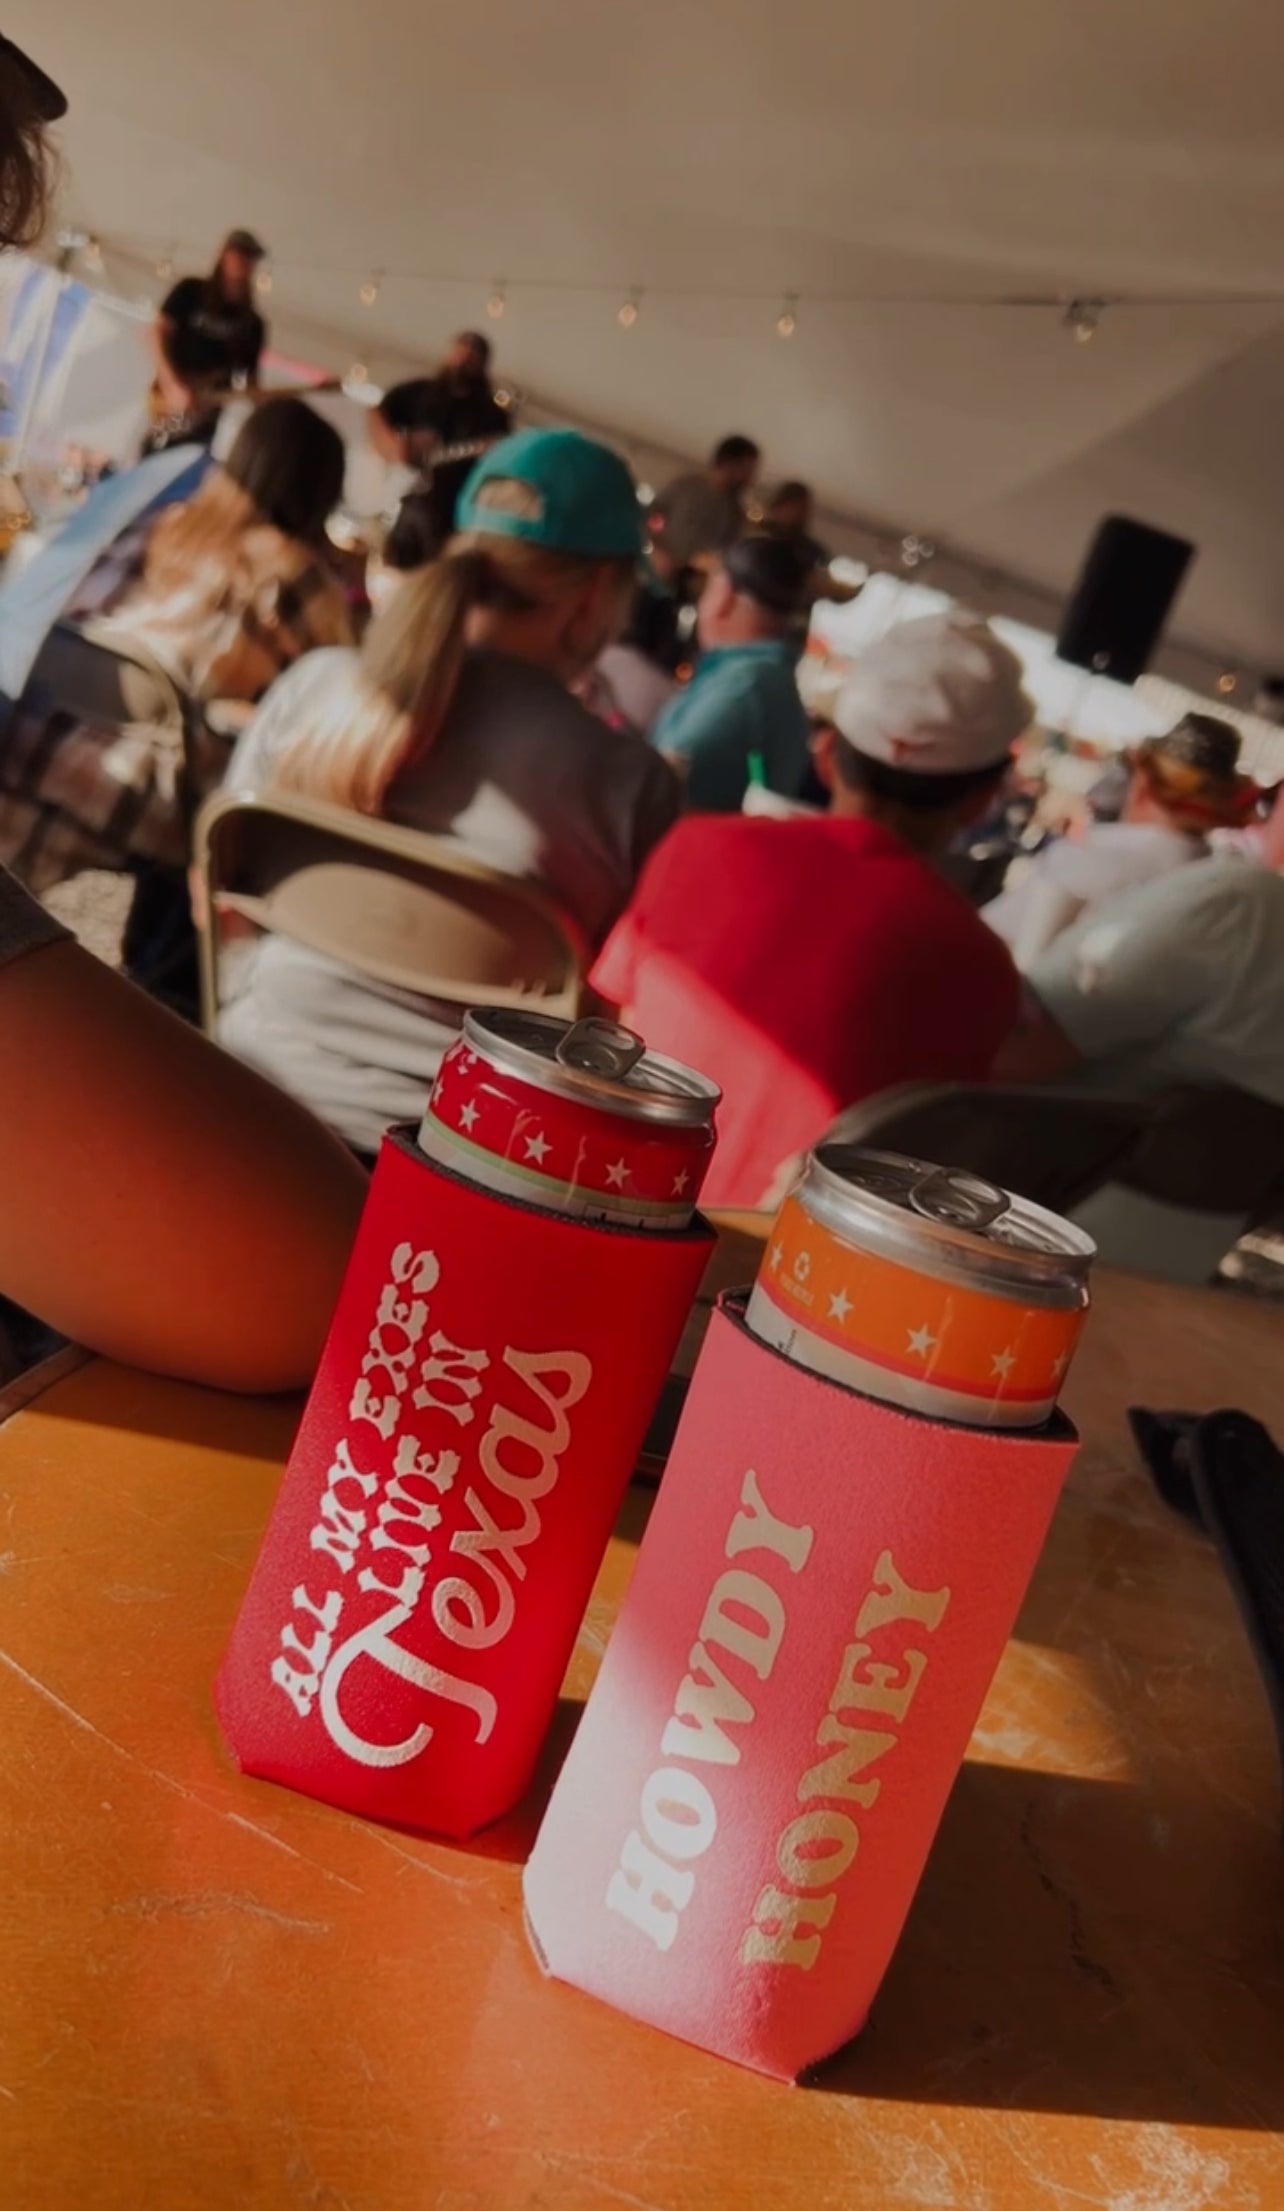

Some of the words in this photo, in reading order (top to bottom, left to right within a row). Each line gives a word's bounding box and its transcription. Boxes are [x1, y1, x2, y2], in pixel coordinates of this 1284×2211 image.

[271, 1584, 344, 1717] ALL
[310, 1438, 378, 1573] MY
[349, 1242, 440, 1440] EXES
[318, 1345, 593, 1769] Texas
[357, 1434, 462, 1610] LIVE
[412, 1330, 491, 1427] IN
[606, 1469, 814, 1951] HOWDY
[738, 1550, 951, 1971] HONEY
